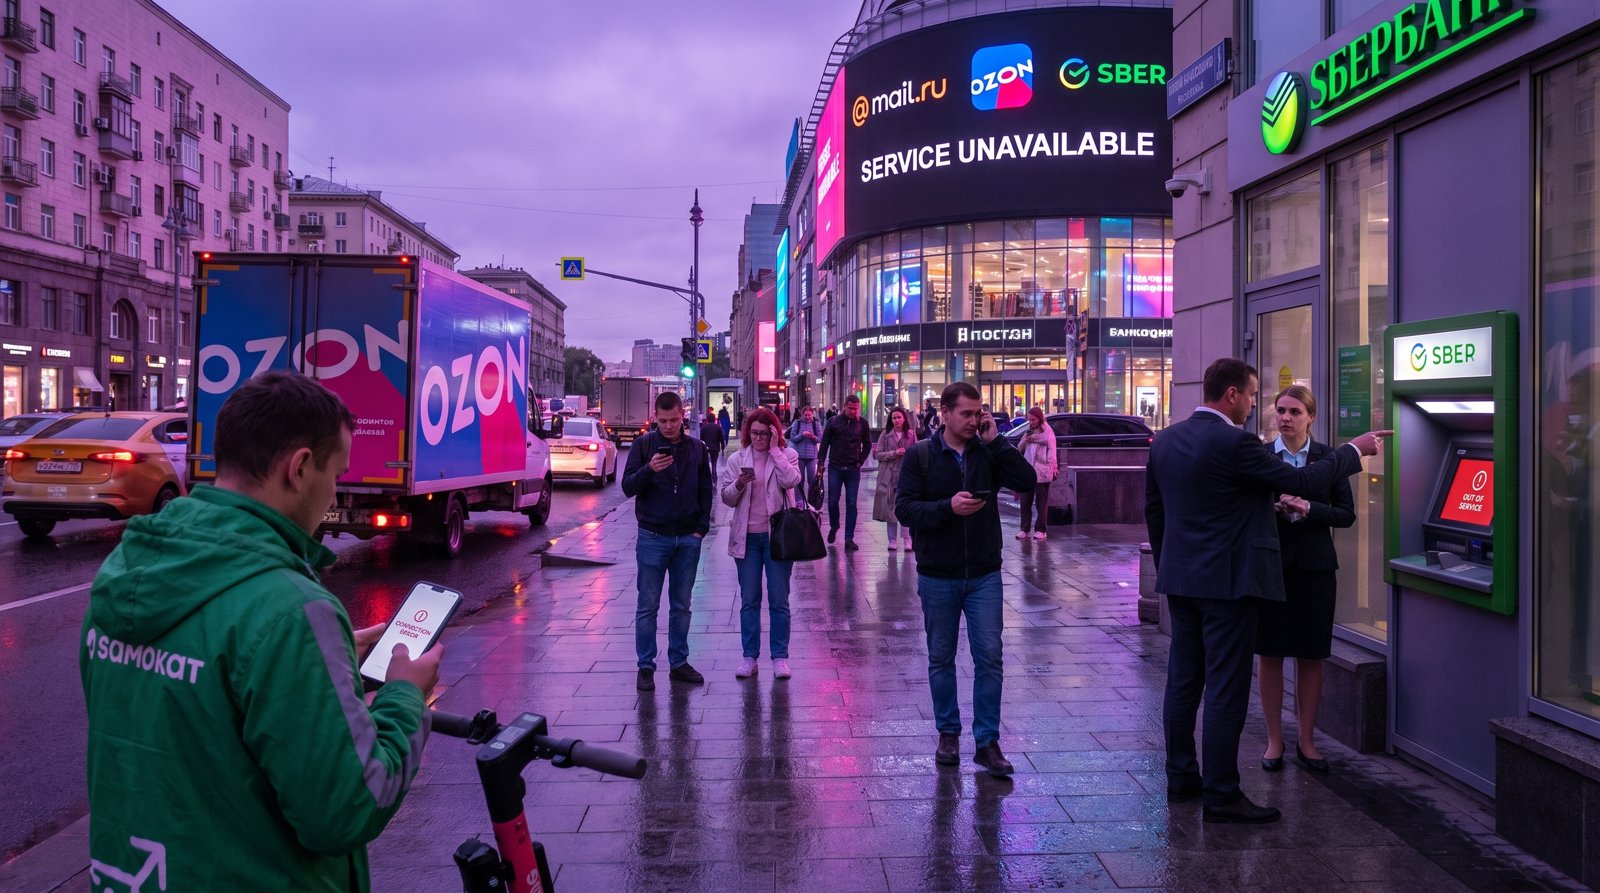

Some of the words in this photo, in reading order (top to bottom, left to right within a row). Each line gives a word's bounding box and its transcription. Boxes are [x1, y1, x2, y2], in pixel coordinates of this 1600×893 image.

[971, 59, 1034, 96] OZON
[1097, 63, 1166, 85] SBER
[861, 142, 951, 183] SERVICE
[958, 131, 1155, 164] UNAVAILABLE
[1432, 343, 1476, 365] SBER
[420, 335, 526, 446] OZON
[1458, 502, 1483, 512] SERVICE
[1462, 493, 1476, 502] OUT
[1475, 494, 1485, 502] OF
